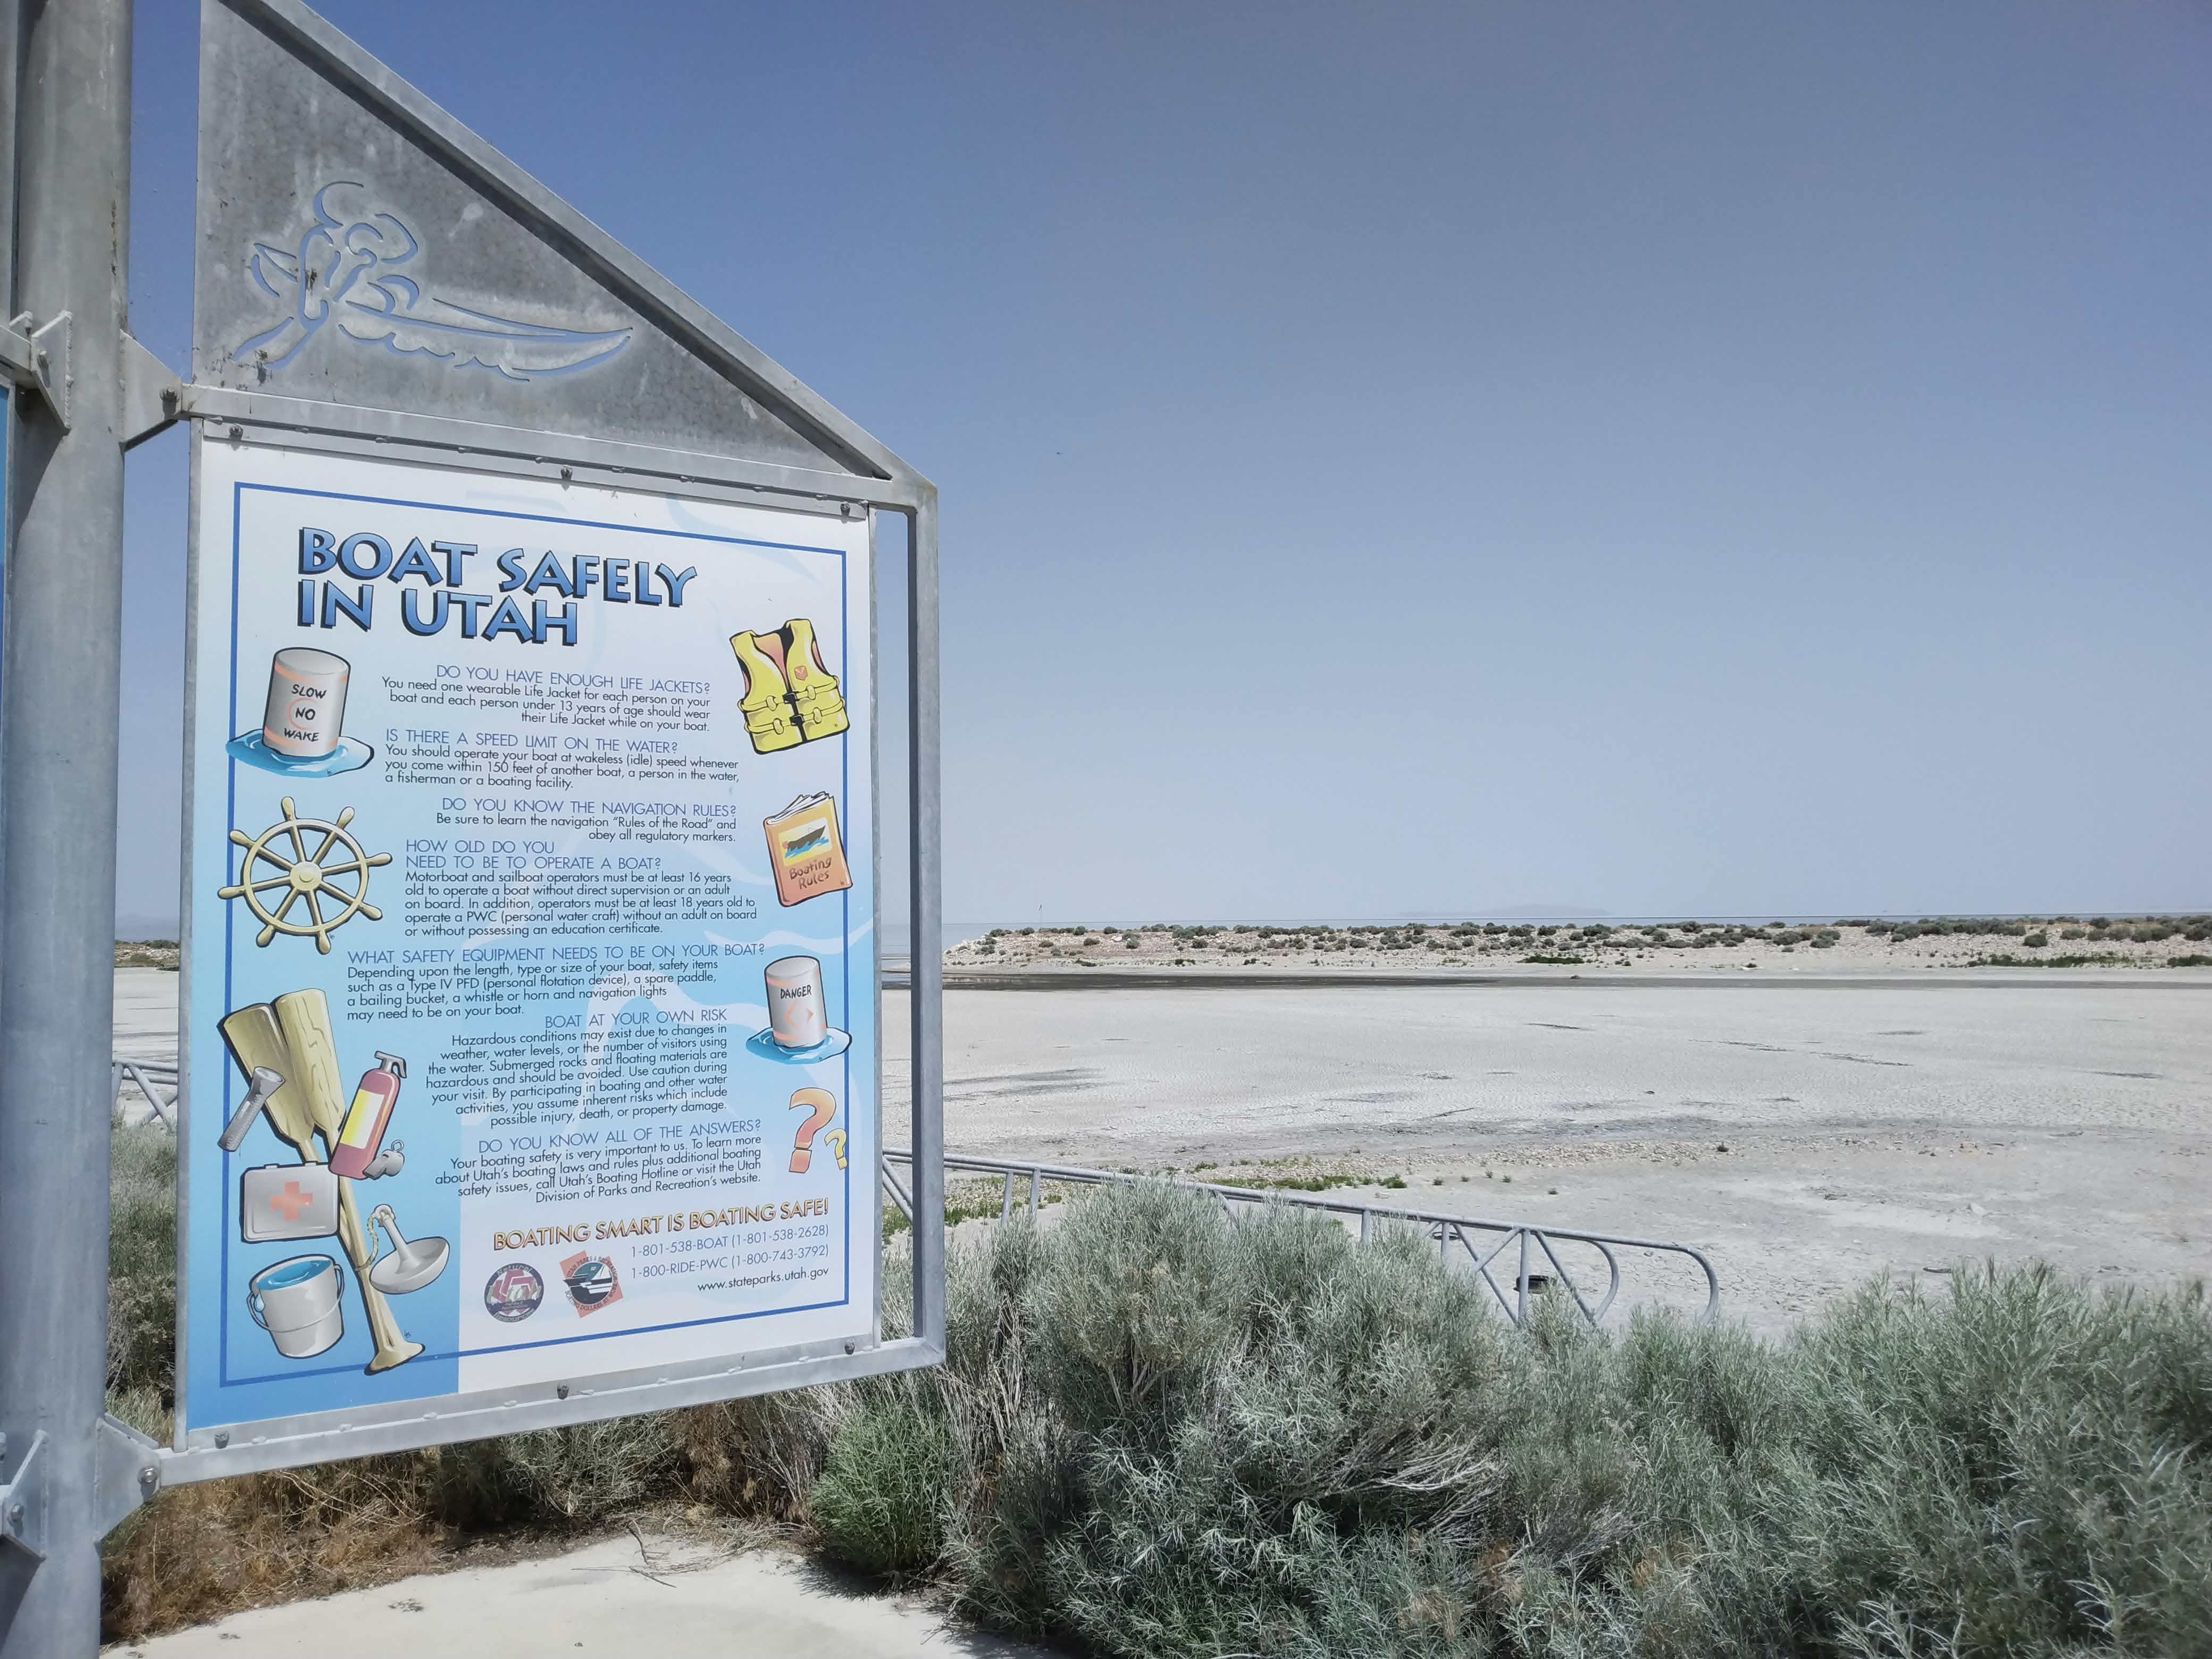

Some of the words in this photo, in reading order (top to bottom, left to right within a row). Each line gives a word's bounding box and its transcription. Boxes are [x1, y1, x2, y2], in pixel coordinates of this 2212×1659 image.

[298, 527, 477, 586] BOAT
[498, 548, 697, 607] SAFELY
[297, 579, 373, 632] IN
[401, 588, 577, 646] UTAH
[437, 665, 460, 678] DO
[465, 666, 498, 681] YOU
[506, 669, 542, 683] HAVE
[550, 672, 613, 688] ENOUGH
[621, 676, 642, 690] LIFE
[649, 678, 709, 694] JACKETS?
[291, 684, 327, 699] SLOW
[383, 676, 403, 689] You
[408, 678, 437, 690] need
[440, 683, 463, 692] one
[466, 683, 521, 696] wearable
[525, 684, 543, 697] Life
[546, 686, 581, 699] Jacket
[584, 688, 599, 700] for
[602, 690, 627, 702] each
[632, 695, 667, 708] person
[687, 698, 710, 709] your
[295, 707, 316, 720] NO
[283, 728, 320, 742] WAKE
[386, 728, 398, 741] IS
[405, 729, 449, 744] THERE
[456, 732, 468, 744] A
[475, 731, 518, 747] SPEED
[525, 735, 557, 749] LIMIT
[564, 736, 588, 750] ON
[595, 738, 619, 751] THE
[626, 740, 677, 753] WATER?
[388, 744, 407, 756] You
[412, 744, 450, 757] should
[454, 749, 499, 764] operate
[502, 752, 528, 765] your
[532, 749, 557, 761] boat
[560, 752, 572, 762] at
[575, 751, 623, 764] wakeless
[626, 753, 652, 767] (idle)
[656, 755, 686, 771] speed
[690, 756, 739, 768] whenever
[442, 798, 466, 810] DO
[473, 798, 506, 811] YOU
[514, 799, 564, 812] KNOW
[569, 801, 594, 814] THE
[602, 802, 685, 815] NAVIGATION
[693, 804, 736, 817] RULES?
[406, 839, 448, 852] HOW
[455, 840, 484, 853] OLD
[492, 841, 515, 853] DO
[523, 841, 554, 853] YOU
[589, 827, 616, 843] obey
[619, 828, 631, 840] all
[635, 829, 689, 844] regulatory
[692, 830, 735, 841] markers.
[406, 854, 446, 868] NEED
[453, 855, 474, 868] TO
[483, 856, 498, 868] BE
[506, 856, 526, 869] TO
[534, 856, 593, 869] OPERATE
[600, 857, 611, 869] A
[618, 857, 660, 869] BOAT?
[789, 857, 832, 879] Boating
[405, 869, 468, 882] Motorboat
[472, 869, 494, 882] and
[498, 870, 543, 882] sailboat
[547, 873, 599, 886] operators
[603, 873, 627, 882] must
[631, 870, 644, 882] be
[648, 873, 658, 882] at
[661, 870, 685, 882] least
[690, 872, 700, 882] 16
[703, 875, 731, 886] years
[799, 871, 830, 890] Rules
[421, 924, 465, 936] without
[468, 923, 529, 939] possessing
[551, 922, 605, 934] education
[608, 921, 663, 934] certificate.
[347, 950, 395, 964] WHAT
[402, 949, 454, 963] SAFETY
[463, 948, 544, 961] EQUIPMENT
[552, 946, 597, 960] NEEDS
[604, 946, 623, 958] TO
[630, 945, 644, 958] BE
[651, 945, 674, 957] ON
[681, 944, 718, 957] YOUR
[725, 943, 764, 956] BOAT?
[348, 965, 414, 983] Depending
[419, 968, 448, 981] upon
[453, 963, 471, 975] the
[475, 962, 513, 979] length,
[517, 965, 541, 978] type
[560, 962, 582, 973] size
[585, 960, 597, 972] of
[599, 964, 624, 976] your
[627, 959, 655, 972] boat,
[659, 958, 689, 973] safety
[692, 959, 718, 969] items
[780, 984, 812, 999] DANGER
[546, 1015, 582, 1028] BOAT
[589, 1013, 605, 1026] AT
[611, 1012, 649, 1025] YOUR
[656, 1010, 693, 1023] OWN
[701, 1008, 726, 1021] RISK
[491, 1111, 537, 1129] possible
[541, 1110, 574, 1125] injury,
[579, 1105, 613, 1119] death,
[632, 1103, 677, 1119] property
[681, 1100, 726, 1113] damage.
[479, 1139, 502, 1153] DO
[509, 1135, 541, 1151] YOU
[549, 1131, 599, 1147] KNOW
[605, 1129, 627, 1143] ALL
[633, 1127, 652, 1141] OF
[659, 1125, 682, 1138] THE
[689, 1119, 760, 1136] ANSWERS?
[453, 1157, 477, 1169] Your
[481, 1154, 524, 1171] boating
[529, 1150, 562, 1167] safety
[566, 1149, 573, 1160] is
[577, 1150, 601, 1161] very
[605, 1143, 657, 1161] important
[660, 1142, 669, 1152] to
[693, 1138, 702, 1149] To
[706, 1136, 731, 1148] learn
[735, 1136, 761, 1145] more
[493, 1222, 591, 1251] BOATING
[596, 1216, 663, 1240] SMART
[668, 1214, 685, 1232] IS
[689, 1204, 777, 1230] BOATING
[781, 1197, 830, 1220] SAFE!
[632, 1236, 727, 1258] 1-801-538-BOAT
[732, 1224, 828, 1248] (1-801-538-2628)
[632, 1256, 727, 1278] 1-800-RIDE-PWC
[732, 1244, 828, 1269] (1-800-743-3792)
[697, 1266, 828, 1291] www.stateparks.utah.gov
